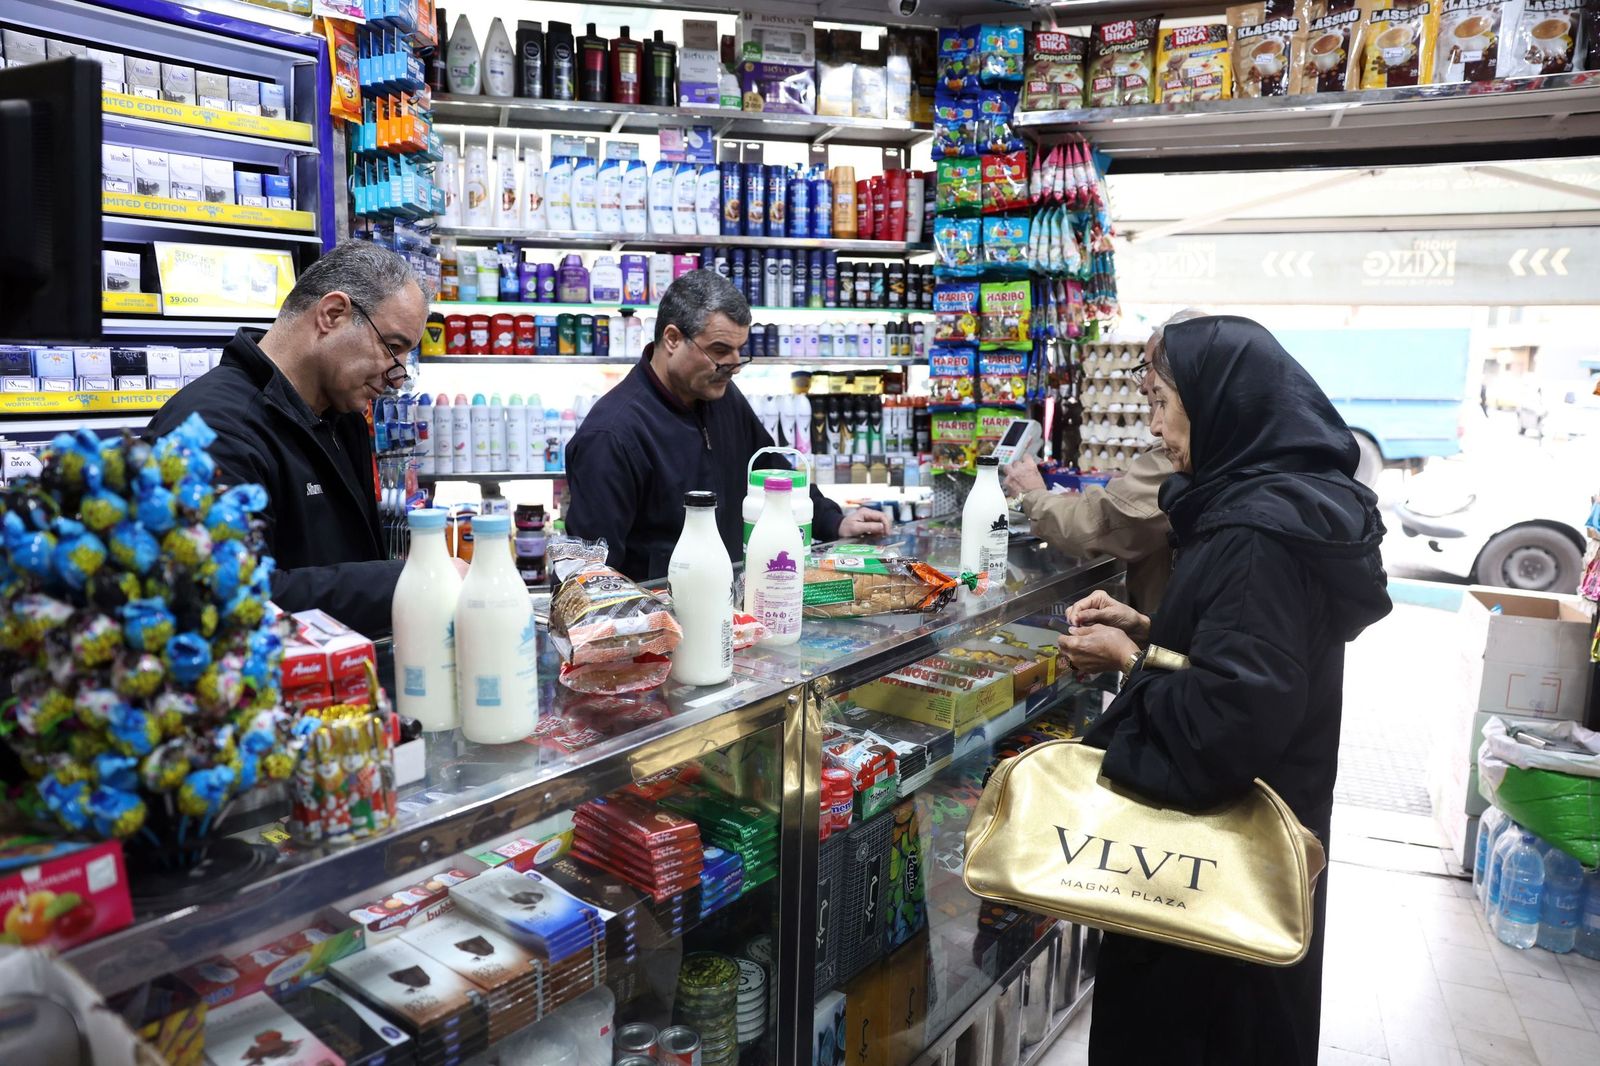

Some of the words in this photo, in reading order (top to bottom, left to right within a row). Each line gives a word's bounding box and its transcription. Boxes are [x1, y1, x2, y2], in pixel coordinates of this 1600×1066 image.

[1371, 3, 1430, 24] LASSNO
[1310, 9, 1360, 30] LASSNO
[1102, 20, 1134, 33] TORA
[1238, 19, 1298, 39] KLASSNO
[1037, 33, 1067, 42] TORA
[1105, 28, 1134, 41] BIKA
[1176, 33, 1206, 45] BIKA
[1039, 41, 1067, 50] BIKA
[1100, 38, 1149, 56] Cappuccino
[1033, 53, 1082, 62] Cappuccino
[102, 97, 135, 109] MITED
[137, 103, 182, 117] EDITION
[193, 109, 221, 120] CAMEL
[102, 196, 141, 209] IMITED
[144, 202, 187, 213] EDITION
[197, 205, 224, 215] CAMEL
[114, 258, 139, 267] Winston
[169, 296, 199, 304] 39,000
[938, 293, 974, 301] HARIBO
[986, 292, 1025, 301] HARIBO
[933, 357, 968, 366] HARBO
[987, 354, 1022, 364] HARIBO
[68, 393, 100, 402] CAMEL
[112, 395, 154, 404] LIMITED
[937, 421, 976, 430] HARIBO
[982, 417, 1011, 427] HARIB
[914, 658, 995, 679] TOBLERON
[1052, 824, 1218, 892] VLVT
[906, 852, 918, 893] Papia
[1060, 878, 1122, 895] MAGNA
[1131, 890, 1187, 910] PLAZA
[427, 901, 456, 921] bubb
